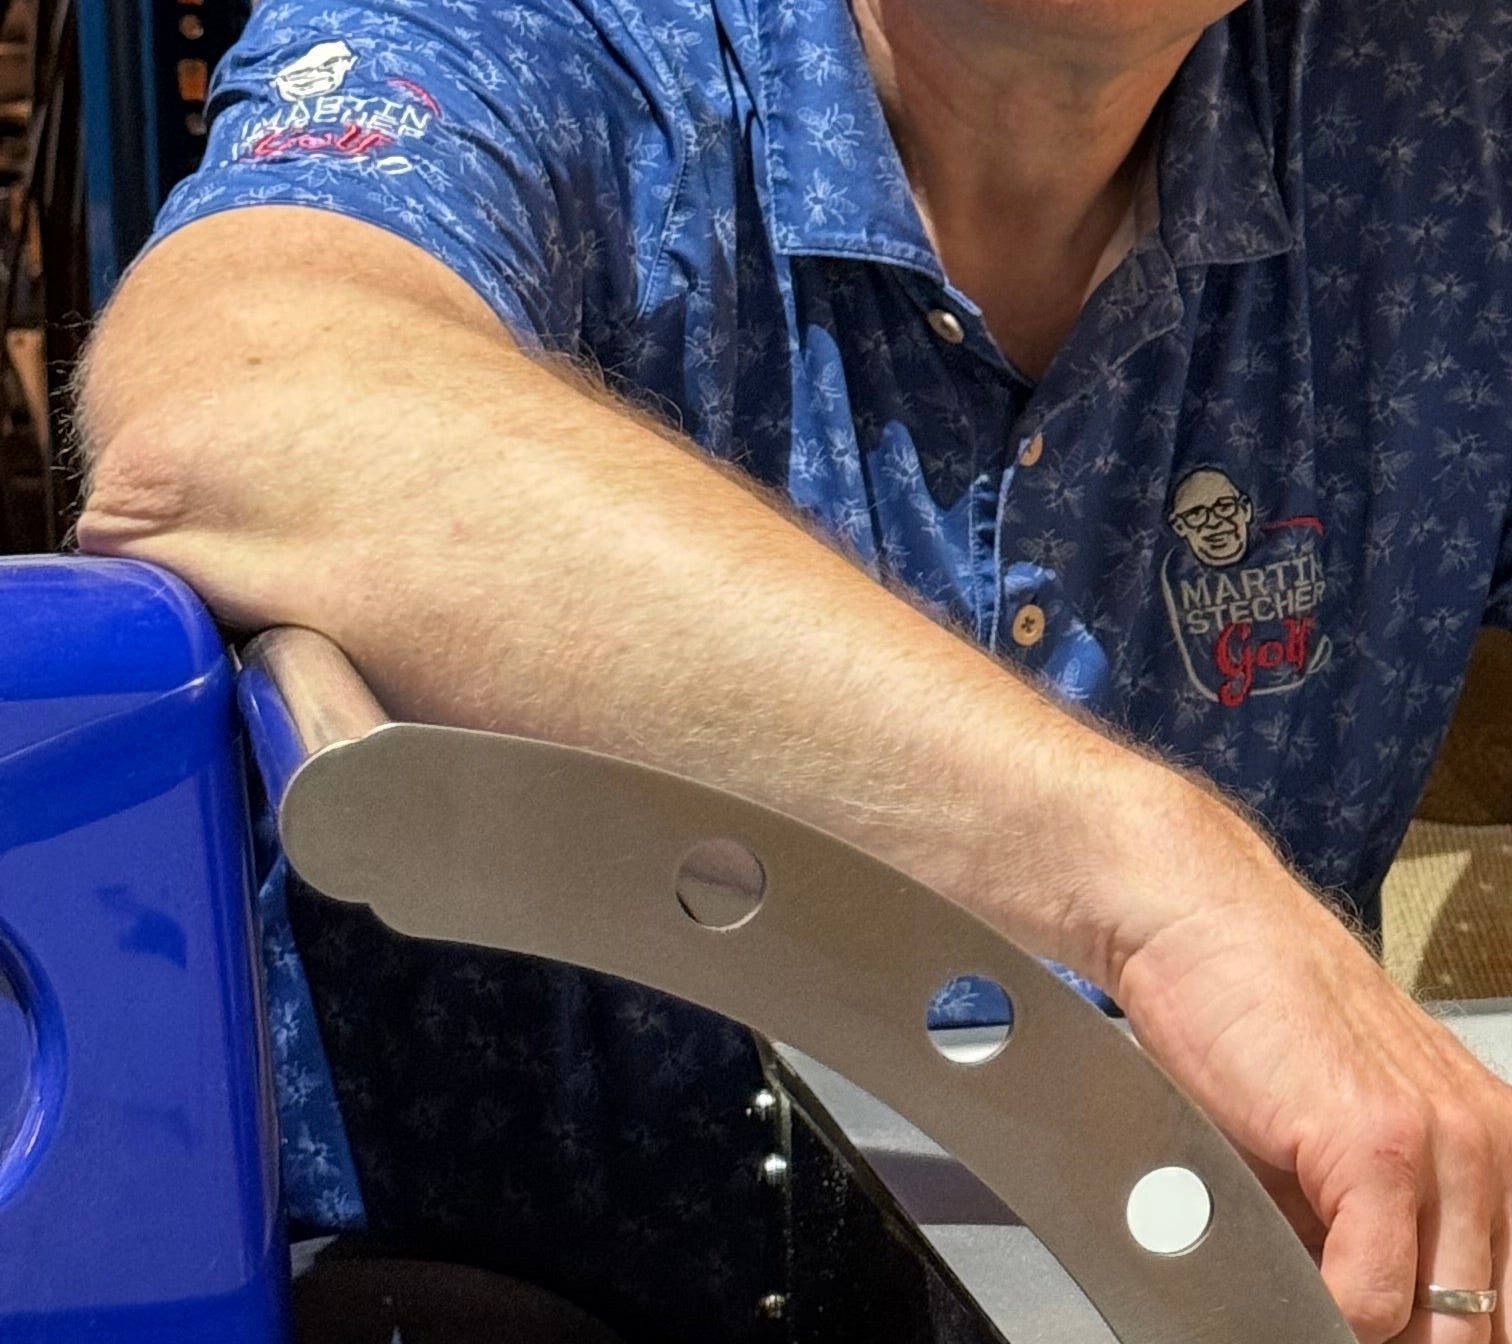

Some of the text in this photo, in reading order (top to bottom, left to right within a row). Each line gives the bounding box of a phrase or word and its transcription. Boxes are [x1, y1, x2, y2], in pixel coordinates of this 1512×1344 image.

[1180, 551, 1326, 610] MARTIN
[1186, 580, 1326, 635] STECHER
[1215, 614, 1317, 707] Golf
